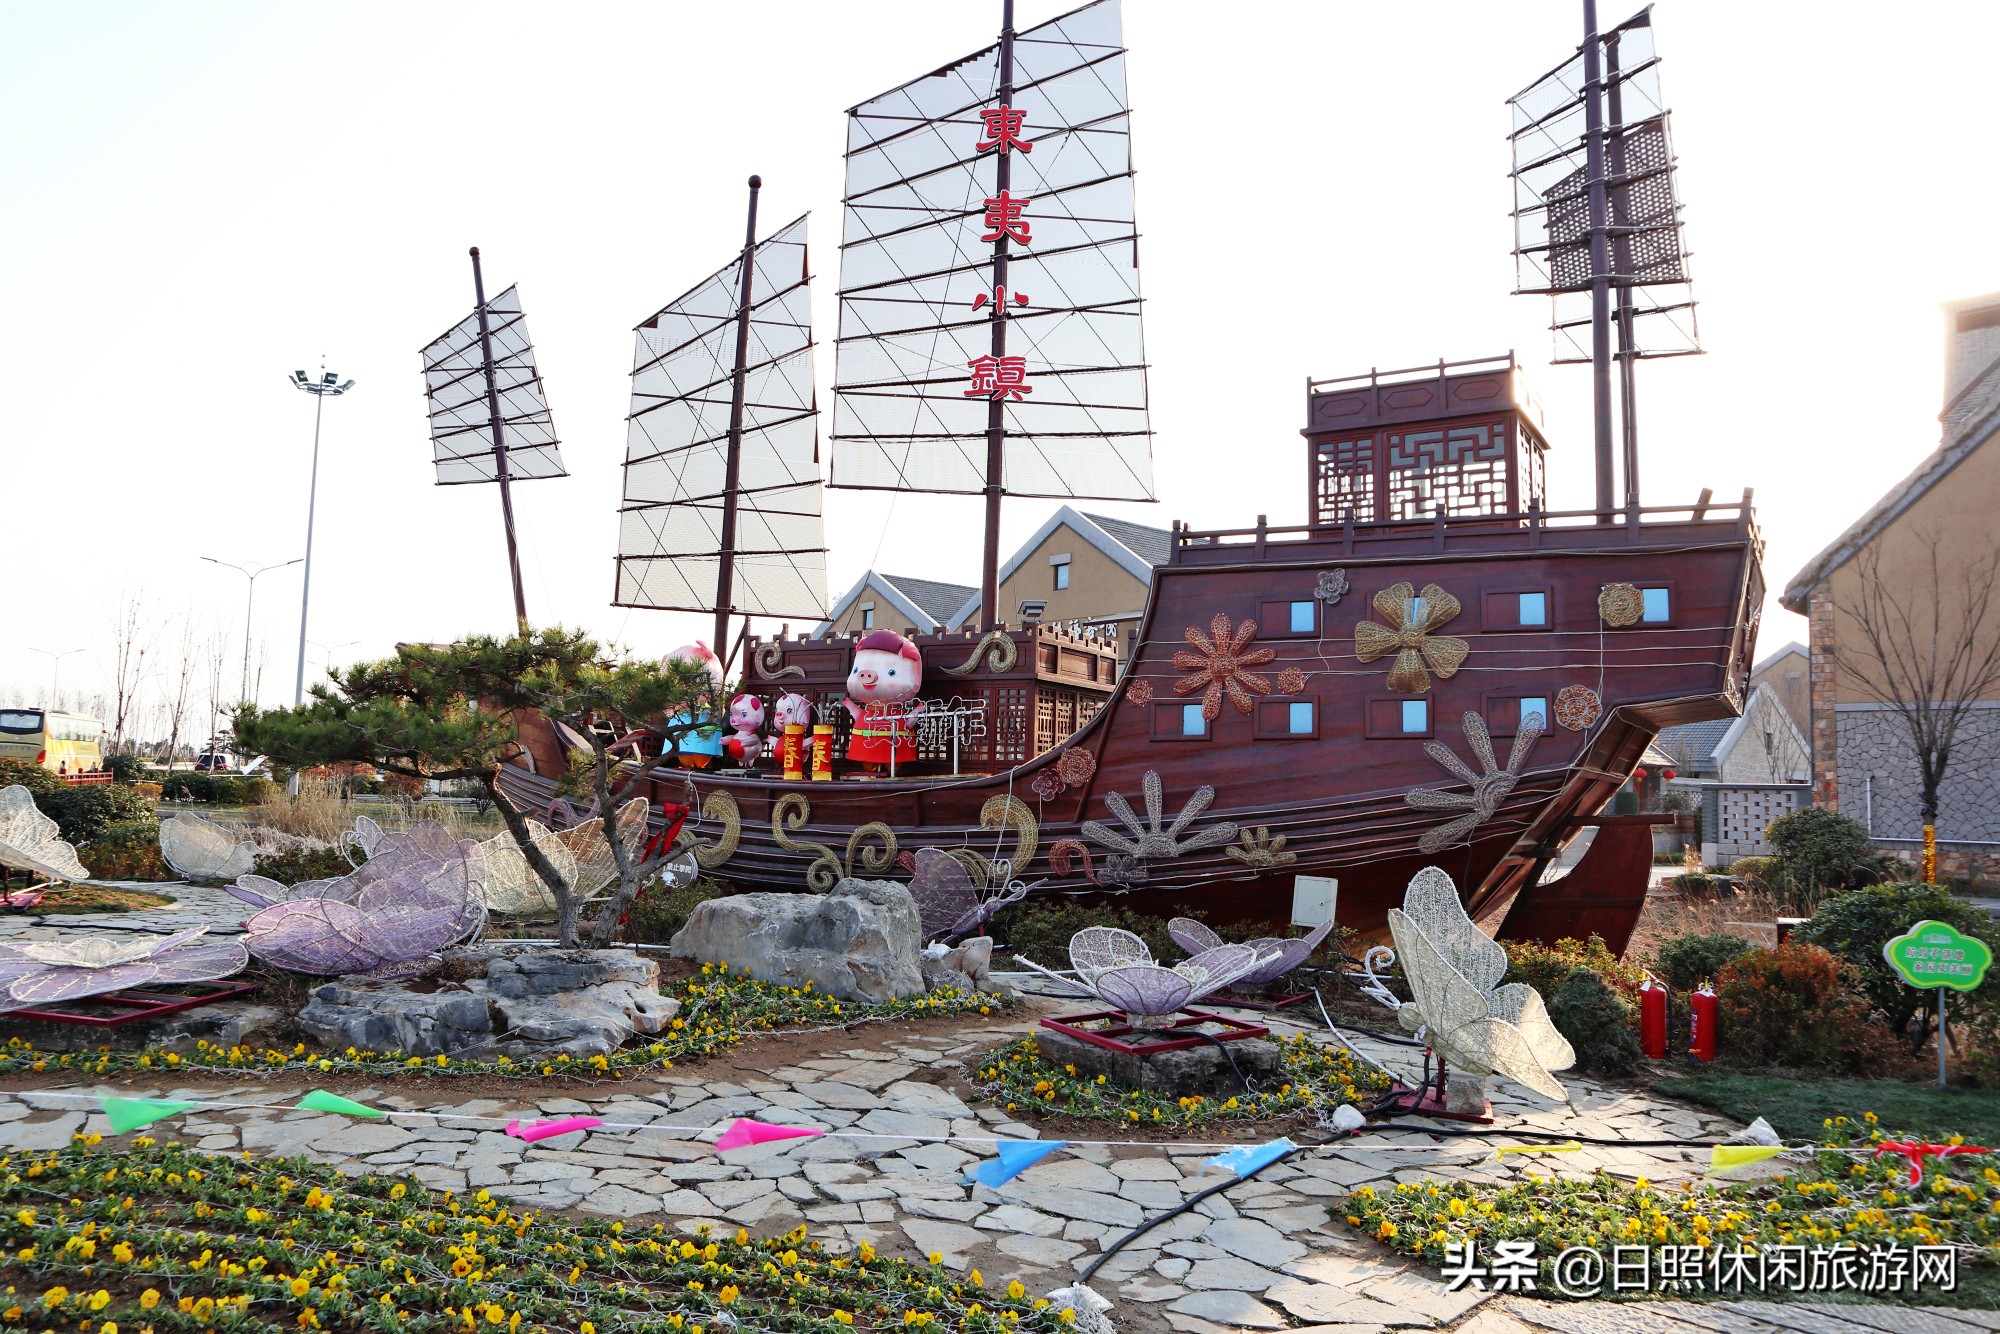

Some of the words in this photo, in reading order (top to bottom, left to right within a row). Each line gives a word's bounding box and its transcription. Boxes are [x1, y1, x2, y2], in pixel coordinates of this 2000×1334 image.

[964, 104, 1033, 401] 東夷小鎮
[784, 736, 800, 768] 春
[812, 740, 830, 771] 春
